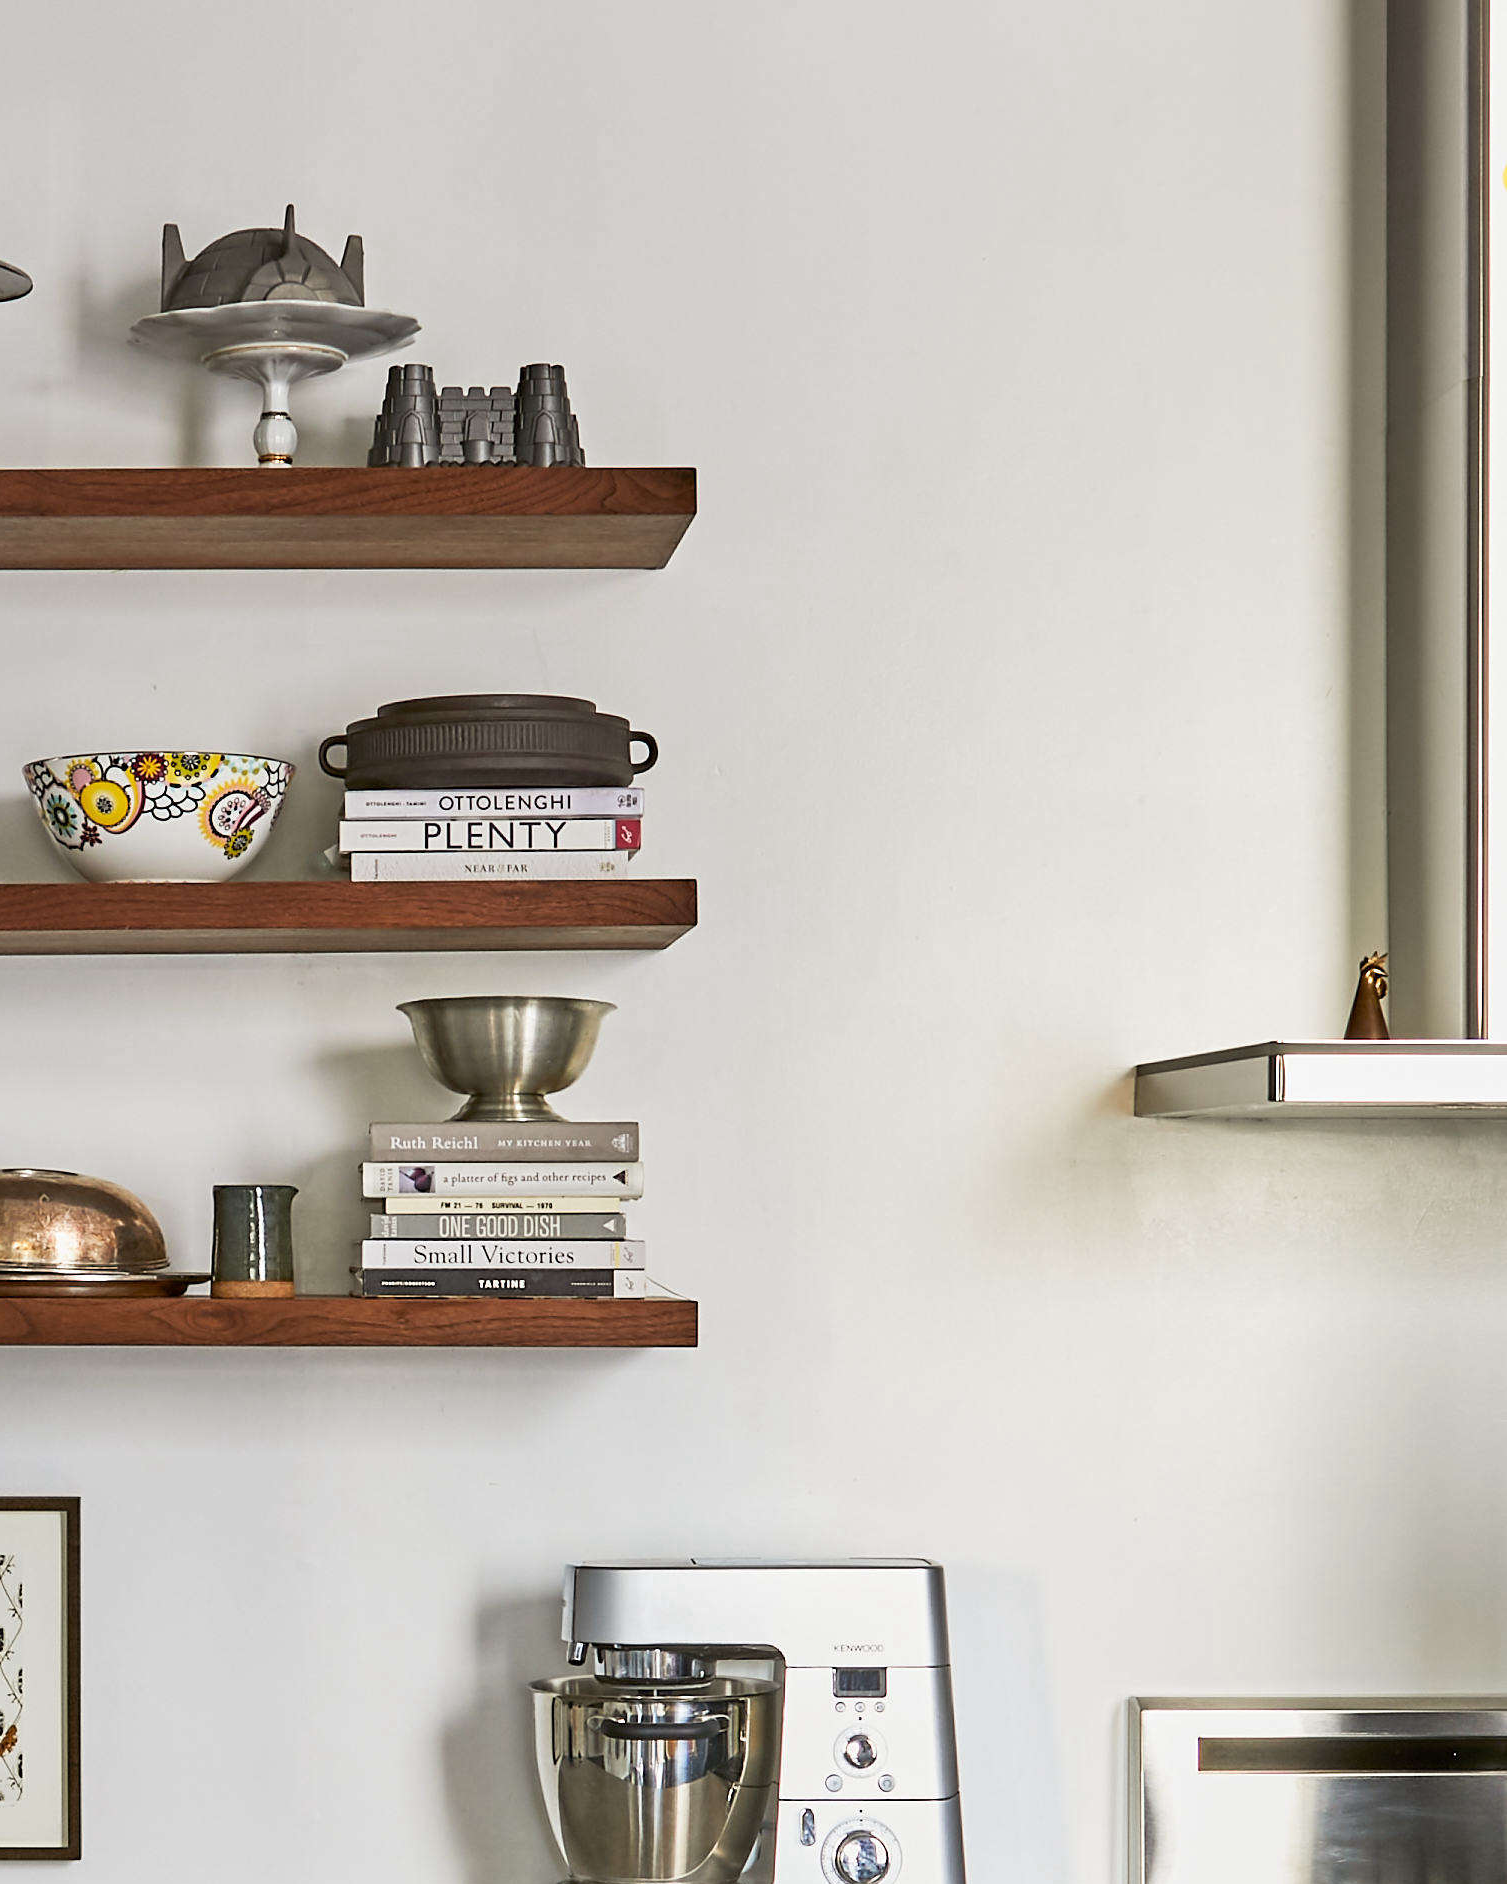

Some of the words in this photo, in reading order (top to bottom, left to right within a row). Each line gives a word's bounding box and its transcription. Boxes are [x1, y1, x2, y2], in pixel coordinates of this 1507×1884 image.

[439, 795, 571, 811] OTTOLENGHI
[424, 822, 566, 849] PLENTY
[464, 864, 495, 873] NEAR
[507, 864, 528, 873] FAR
[390, 1136, 426, 1150] Ruth
[432, 1136, 478, 1150] Reichl
[497, 1139, 513, 1147] MY
[516, 1139, 561, 1147] KITCHEN
[565, 1139, 592, 1147] YEAR
[452, 1173, 484, 1186] platter
[487, 1172, 498, 1182] of
[501, 1172, 518, 1186] figs
[521, 1172, 539, 1182] and
[542, 1172, 569, 1182] other
[572, 1172, 607, 1185] recipes
[439, 1216, 471, 1237] ONE
[476, 1216, 518, 1237] GOOD
[524, 1216, 560, 1237] DISH
[414, 1244, 473, 1264] Small
[482, 1245, 574, 1264] Victories
[478, 1279, 525, 1289] TARTINE
[833, 1644, 884, 1652] KENWOOD
